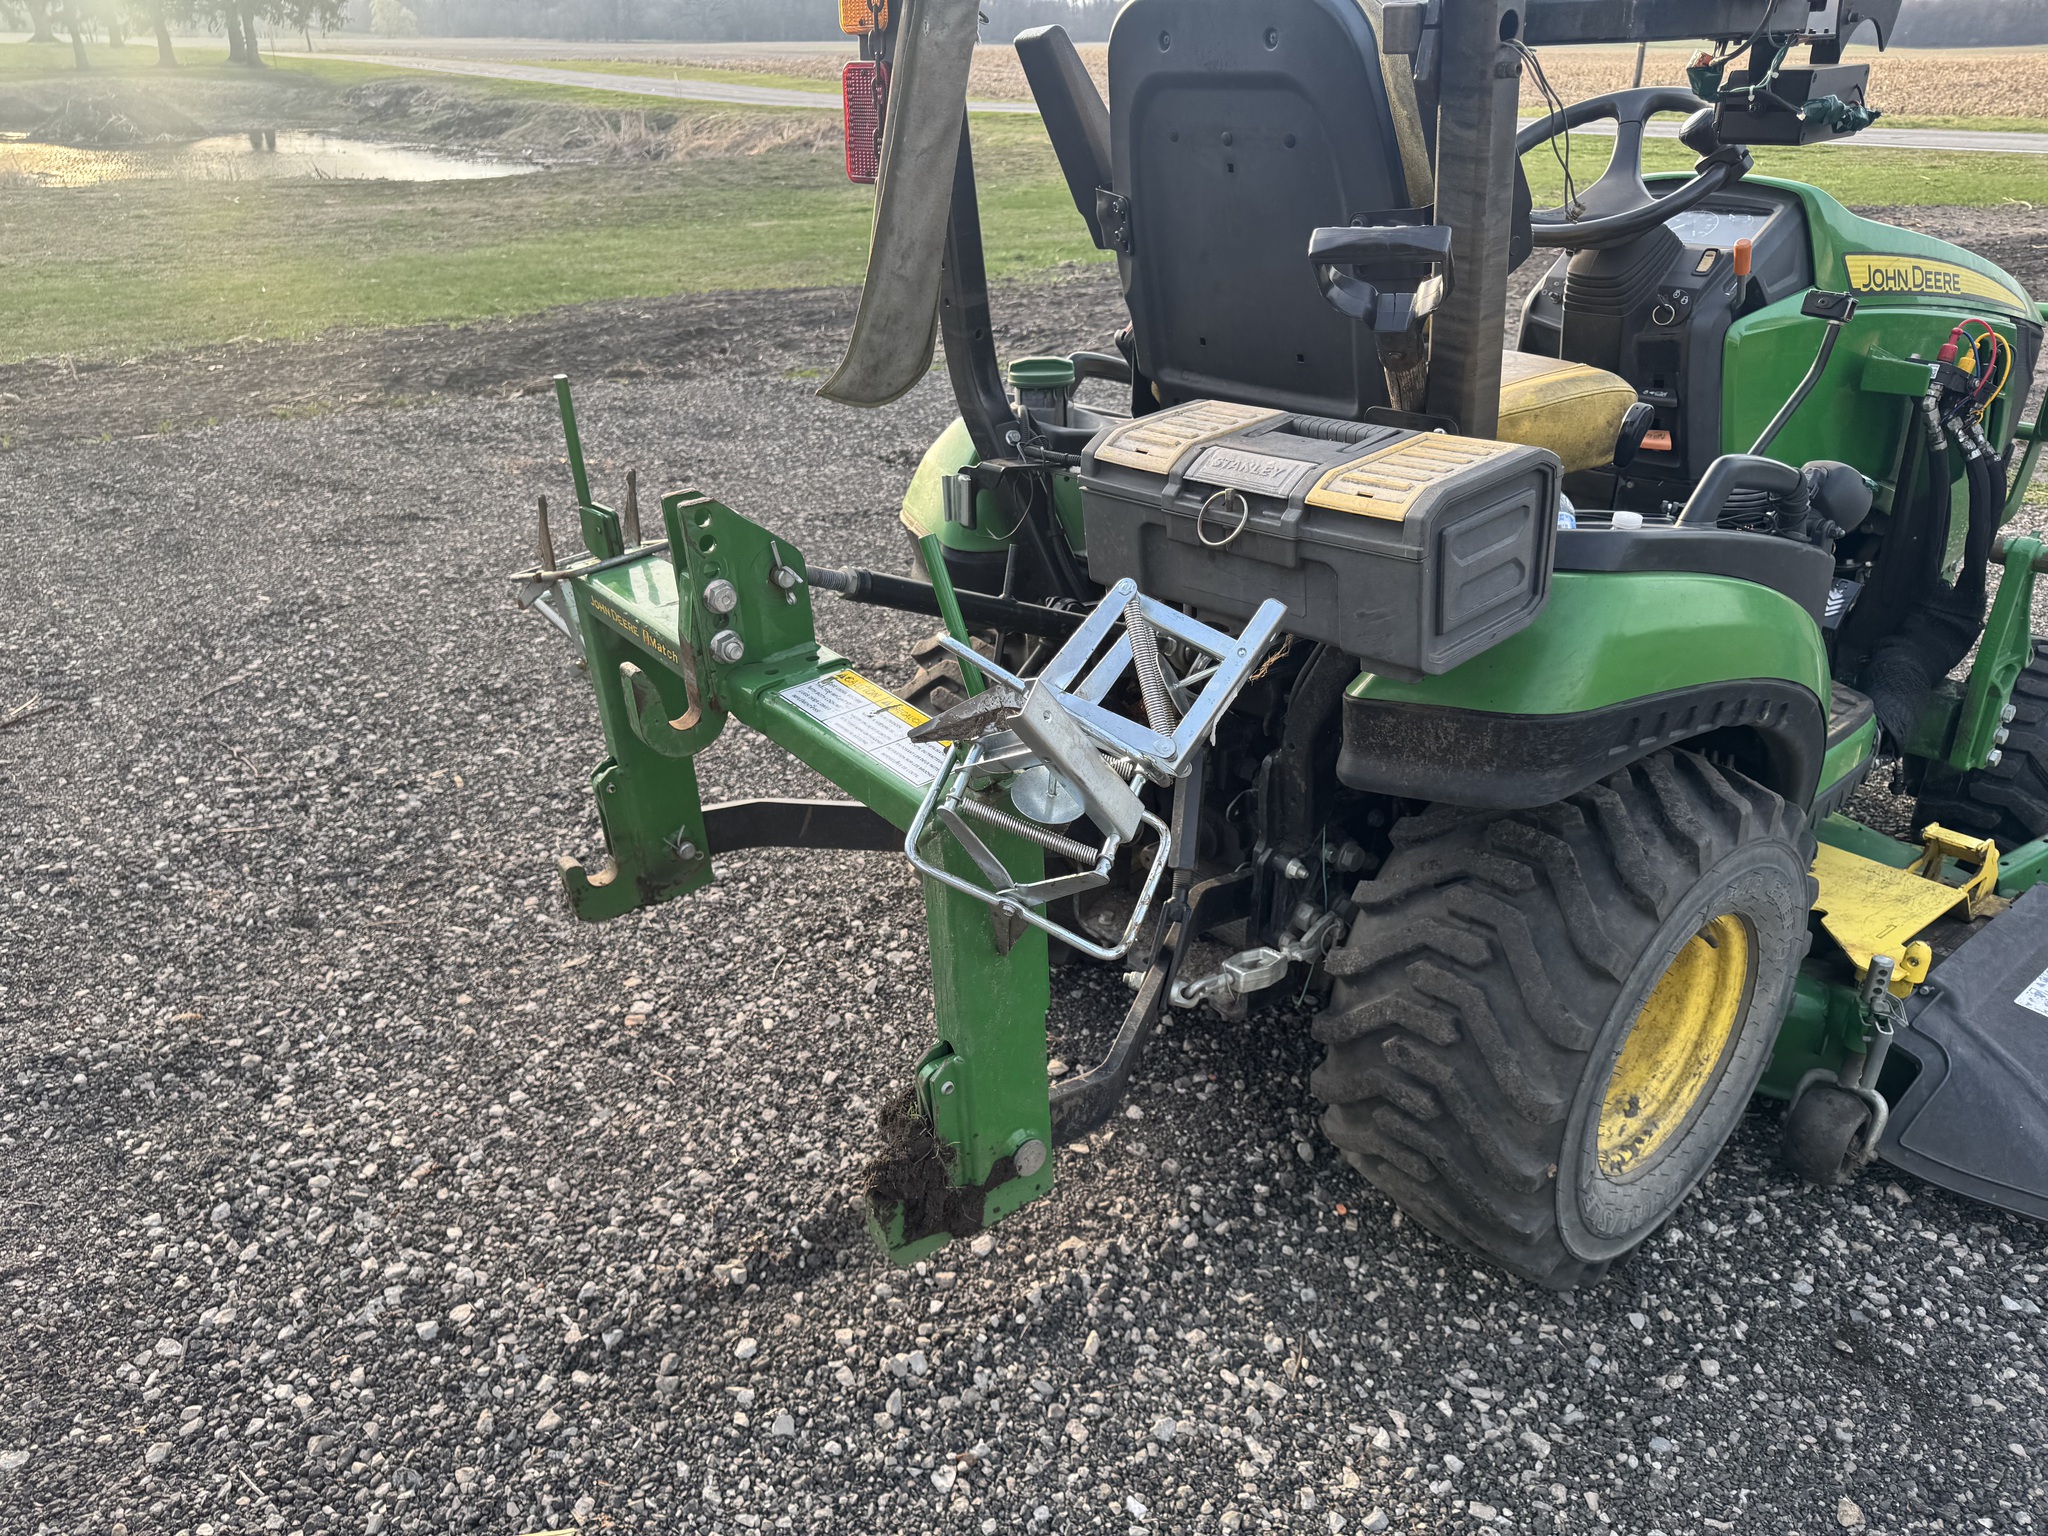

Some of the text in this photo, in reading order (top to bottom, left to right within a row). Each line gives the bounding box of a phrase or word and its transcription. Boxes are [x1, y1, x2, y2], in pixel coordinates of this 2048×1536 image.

[1861, 264, 1961, 292] JOHN DEERE
[1211, 457, 1287, 479] STANLEY
[591, 595, 611, 617] JOHN
[610, 608, 640, 637] DEERE
[844, 676, 881, 698] CAUTION
